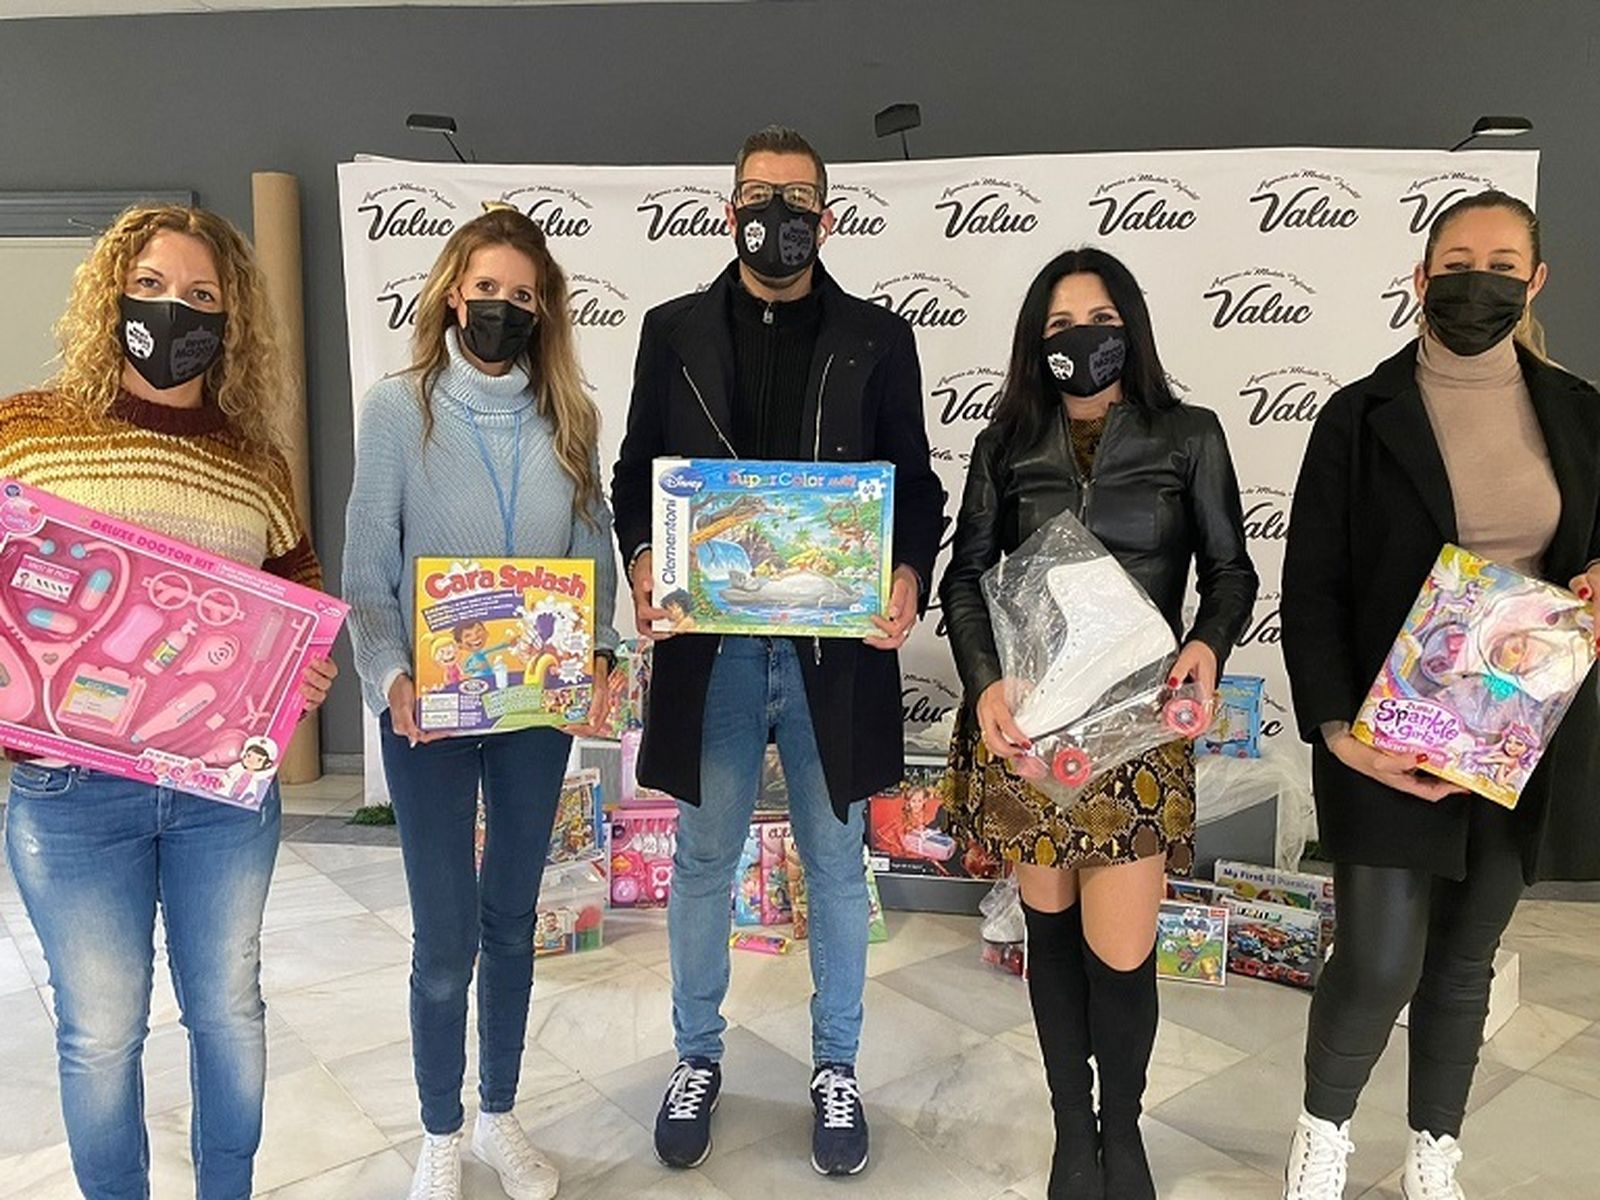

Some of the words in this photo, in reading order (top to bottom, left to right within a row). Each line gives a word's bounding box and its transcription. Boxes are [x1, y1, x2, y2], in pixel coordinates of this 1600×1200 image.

[357, 199, 455, 241] Valuc
[527, 199, 593, 237] luc
[825, 197, 888, 235] luc
[934, 193, 1039, 238] Valuc
[1088, 189, 1197, 236] Valuc
[1249, 186, 1359, 233] Valuc
[567, 289, 627, 327] aluc
[1203, 283, 1313, 329] Valuc
[931, 382, 1001, 425] Val
[1239, 382, 1319, 425] Val
[425, 570, 494, 599] Cara
[500, 565, 586, 598] Splash
[1376, 699, 1459, 740] Sparkle
